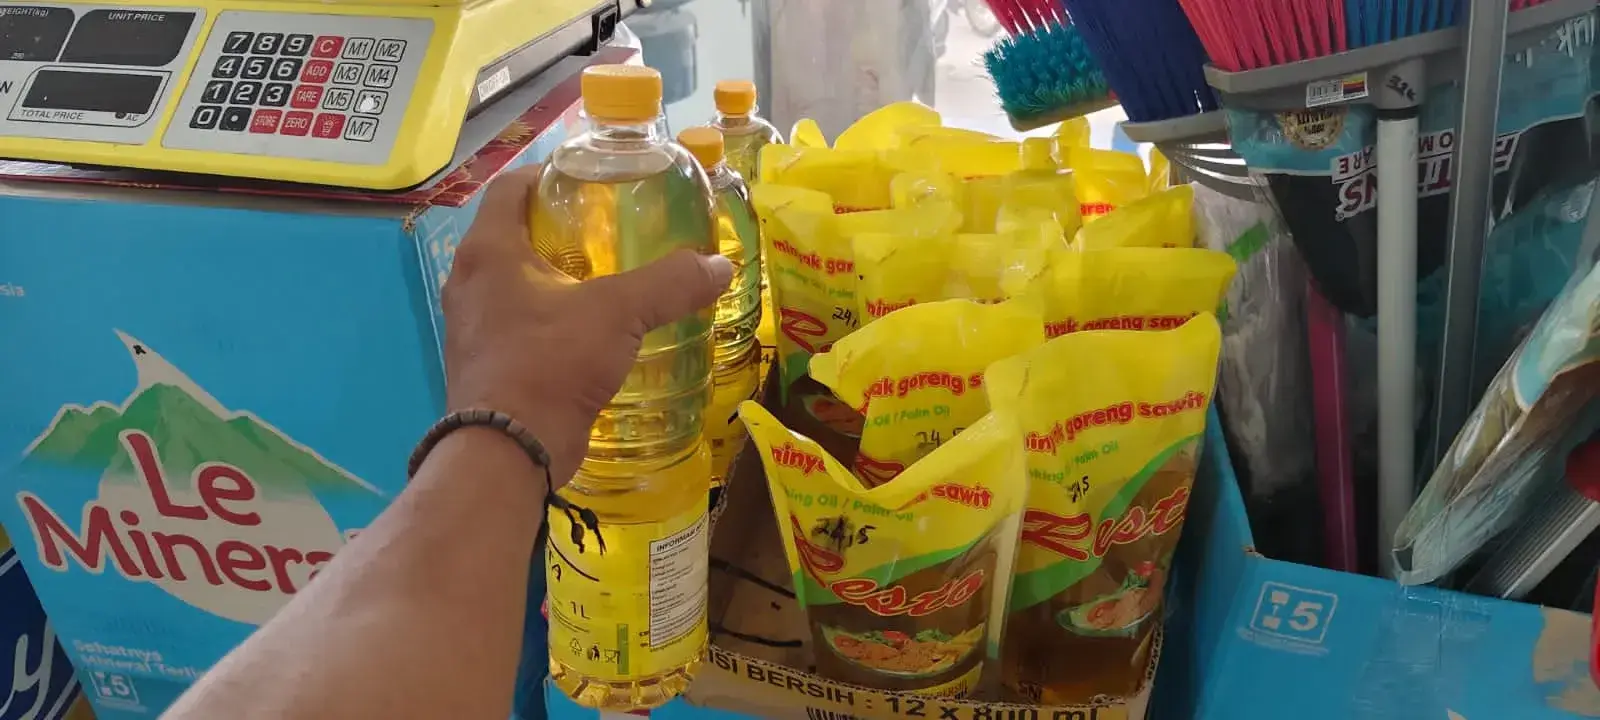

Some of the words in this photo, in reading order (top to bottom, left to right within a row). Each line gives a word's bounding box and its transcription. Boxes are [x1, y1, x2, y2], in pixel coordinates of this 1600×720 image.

[108, 12, 134, 21] UNIT
[135, 13, 166, 22] PRICE
[232, 34, 247, 49] 7
[259, 36, 276, 50] 8
[288, 38, 305, 52] 9
[320, 40, 335, 53] C
[348, 41, 369, 56] M1
[378, 43, 401, 57] M2
[218, 59, 234, 74] 4
[247, 60, 265, 75] 5
[277, 61, 295, 77] 6
[305, 65, 328, 77] ADD
[337, 66, 359, 81] M3
[369, 68, 391, 83] M4
[210, 85, 222, 99] 1
[236, 86, 253, 101] 2
[266, 86, 284, 102] 3
[296, 90, 318, 103] TARE
[327, 92, 349, 107] M5
[21, 109, 53, 119] TOTAL
[54, 111, 84, 121] PRICE
[126, 114, 139, 122] AC
[196, 109, 213, 125] 0
[284, 116, 308, 129] ZERO
[349, 120, 373, 136] M7
[897, 371, 966, 398] goreng
[1065, 401, 1133, 441] goreng
[1136, 391, 1206, 418] sawit
[121, 431, 262, 527] Le
[930, 480, 994, 511] sawit
[19, 494, 345, 596] Minera
[789, 512, 985, 617] Resto
[111, 674, 130, 696] 5
[708, 649, 740, 675] ISI
[747, 664, 855, 706] BERSIH
[884, 697, 927, 717] 12
[939, 705, 961, 720] x
